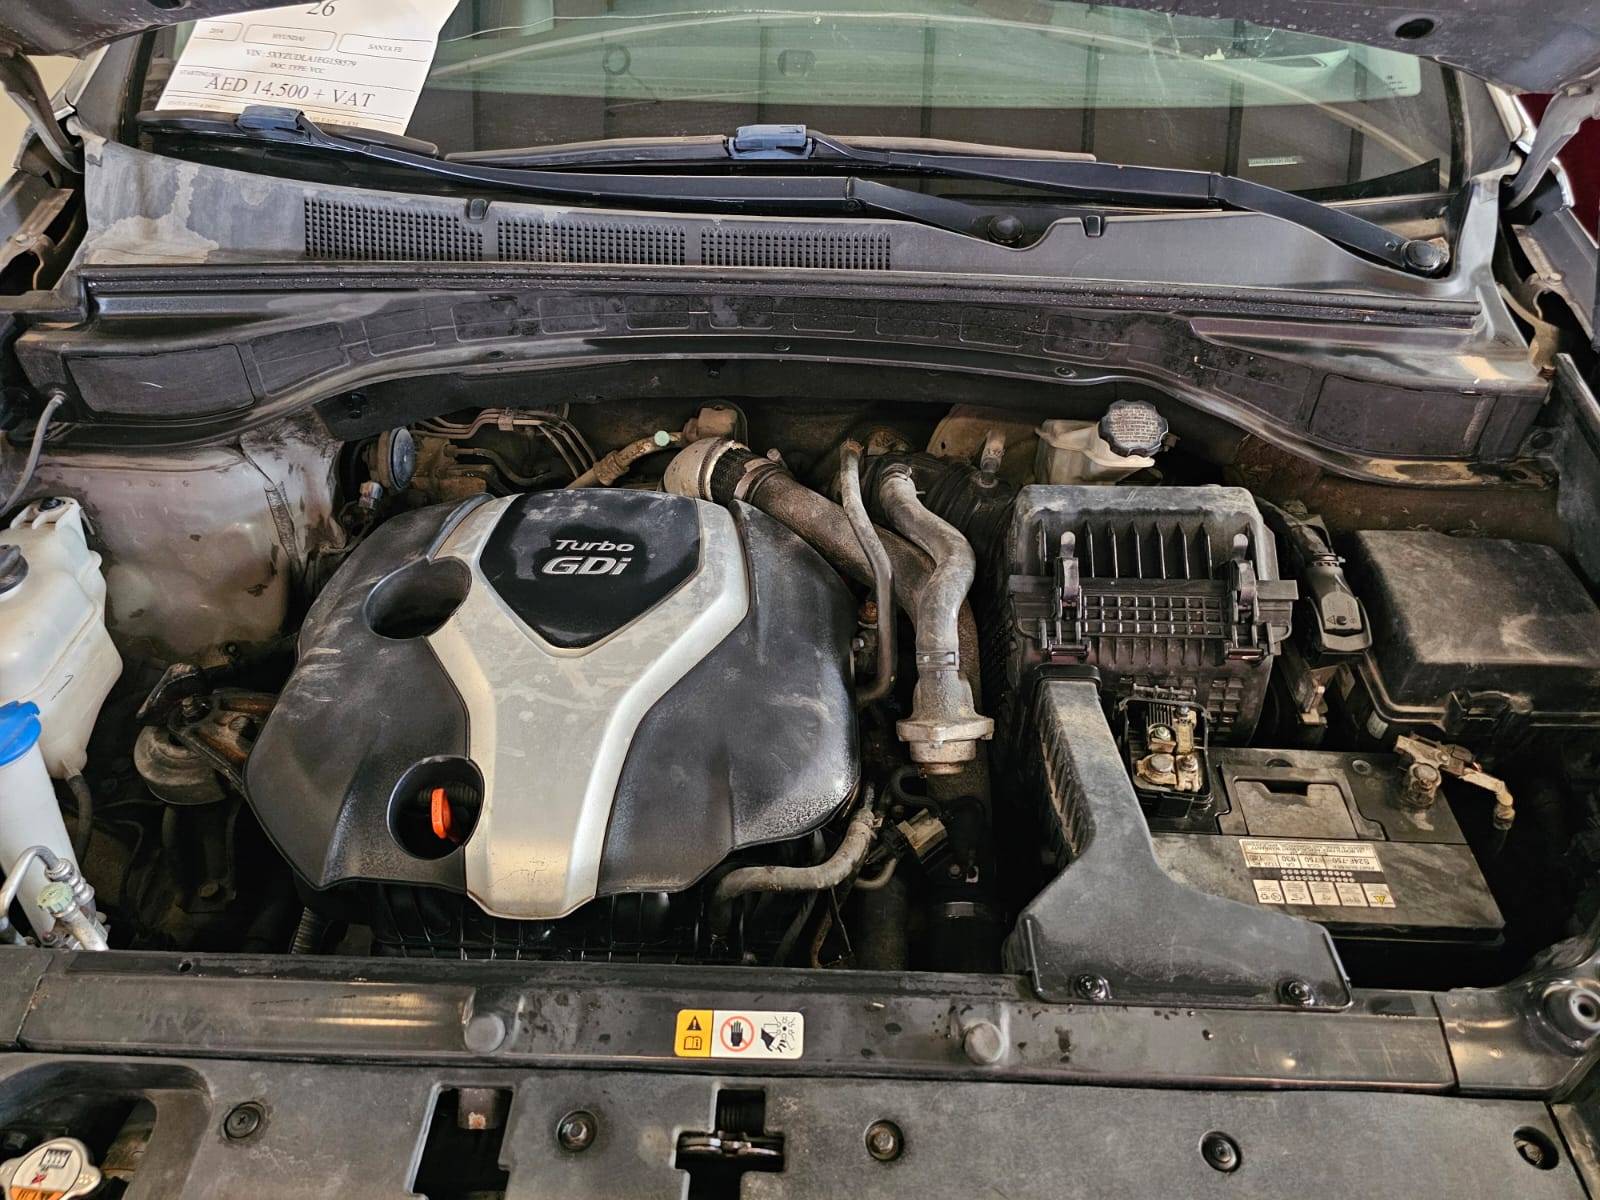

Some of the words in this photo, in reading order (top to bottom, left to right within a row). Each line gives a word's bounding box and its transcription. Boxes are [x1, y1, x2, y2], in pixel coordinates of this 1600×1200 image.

[306, 0, 337, 17] 26
[204, 76, 249, 93] AED
[333, 89, 376, 107] VAT
[555, 539, 635, 552] Turbo
[542, 555, 632, 575] GDi
